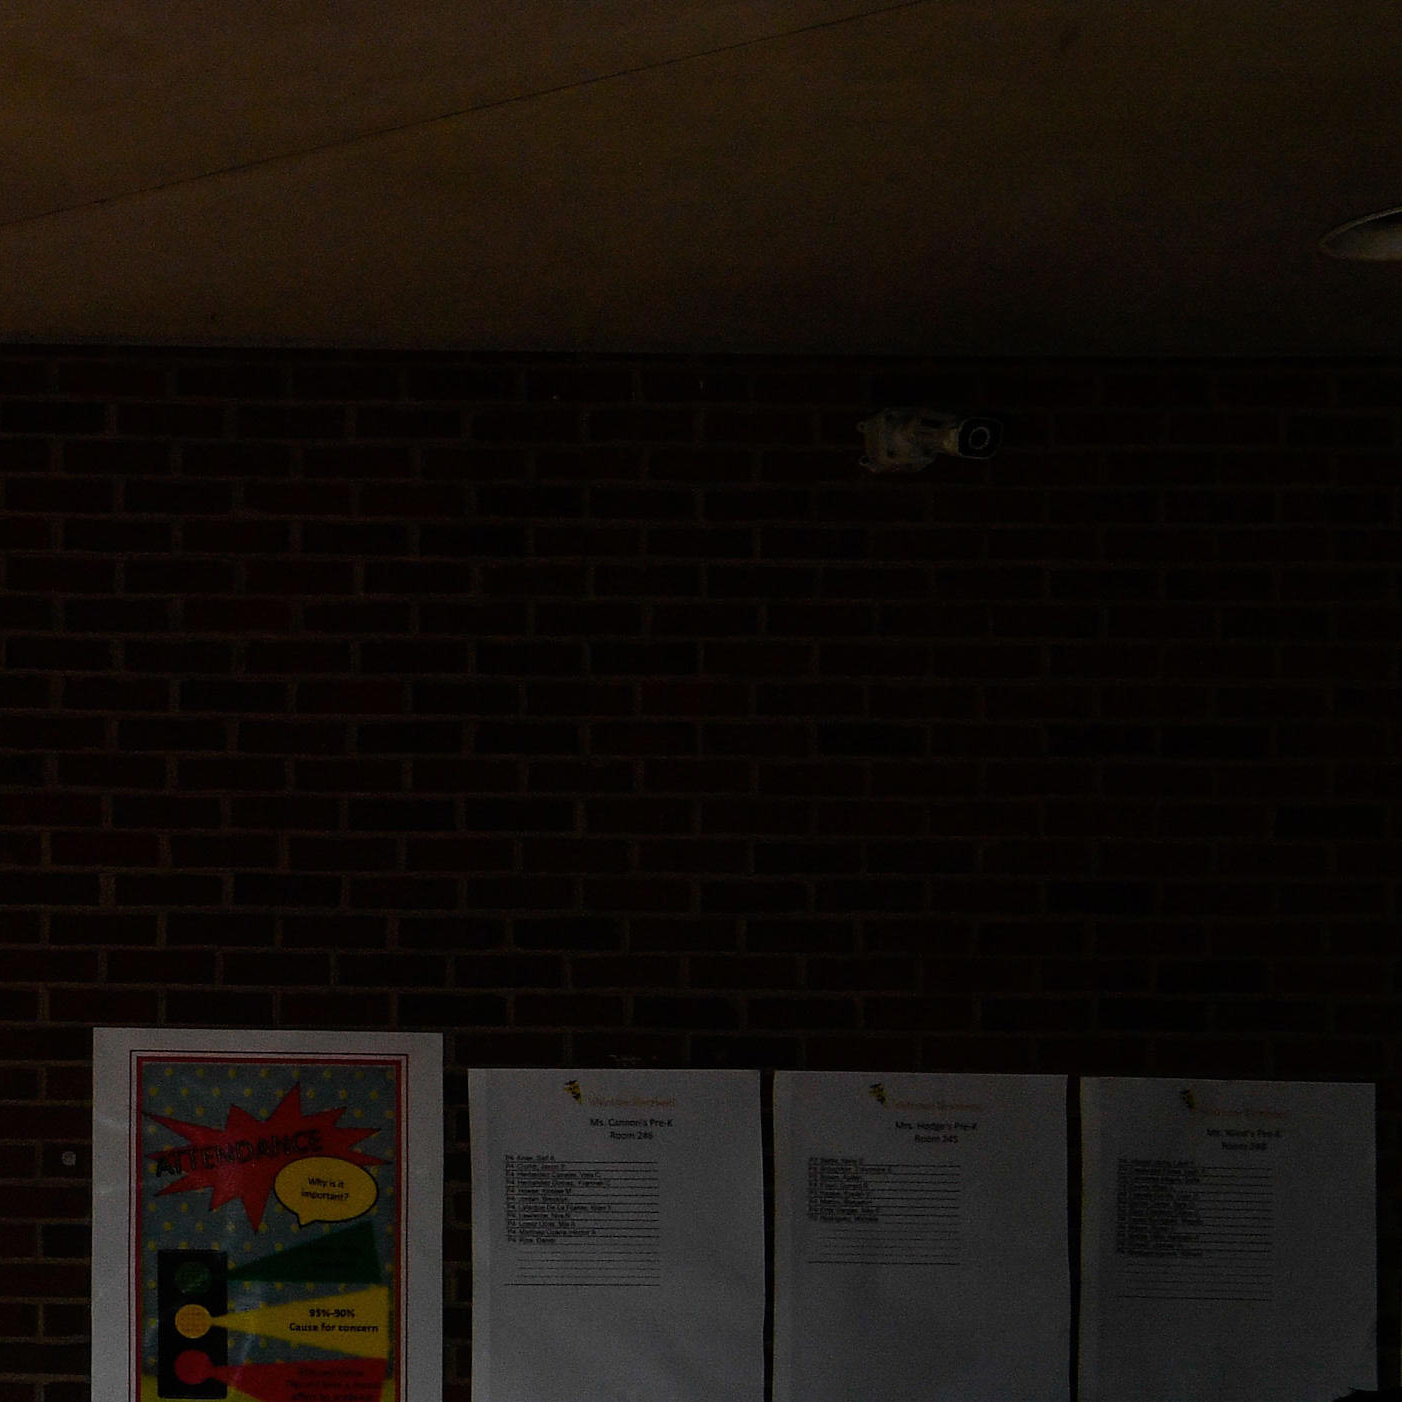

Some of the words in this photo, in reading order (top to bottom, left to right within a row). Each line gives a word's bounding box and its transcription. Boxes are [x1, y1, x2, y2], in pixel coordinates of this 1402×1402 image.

[610, 1132, 635, 1140] Room
[155, 1128, 323, 1177] ATTENDANCE
[308, 1177, 327, 1189] Why
[329, 1178, 337, 1187] is
[338, 1179, 345, 1188] it
[301, 1189, 349, 1202] important?
[289, 1322, 319, 1332] Cause
[321, 1322, 336, 1332] for
[338, 1325, 379, 1333] concern
